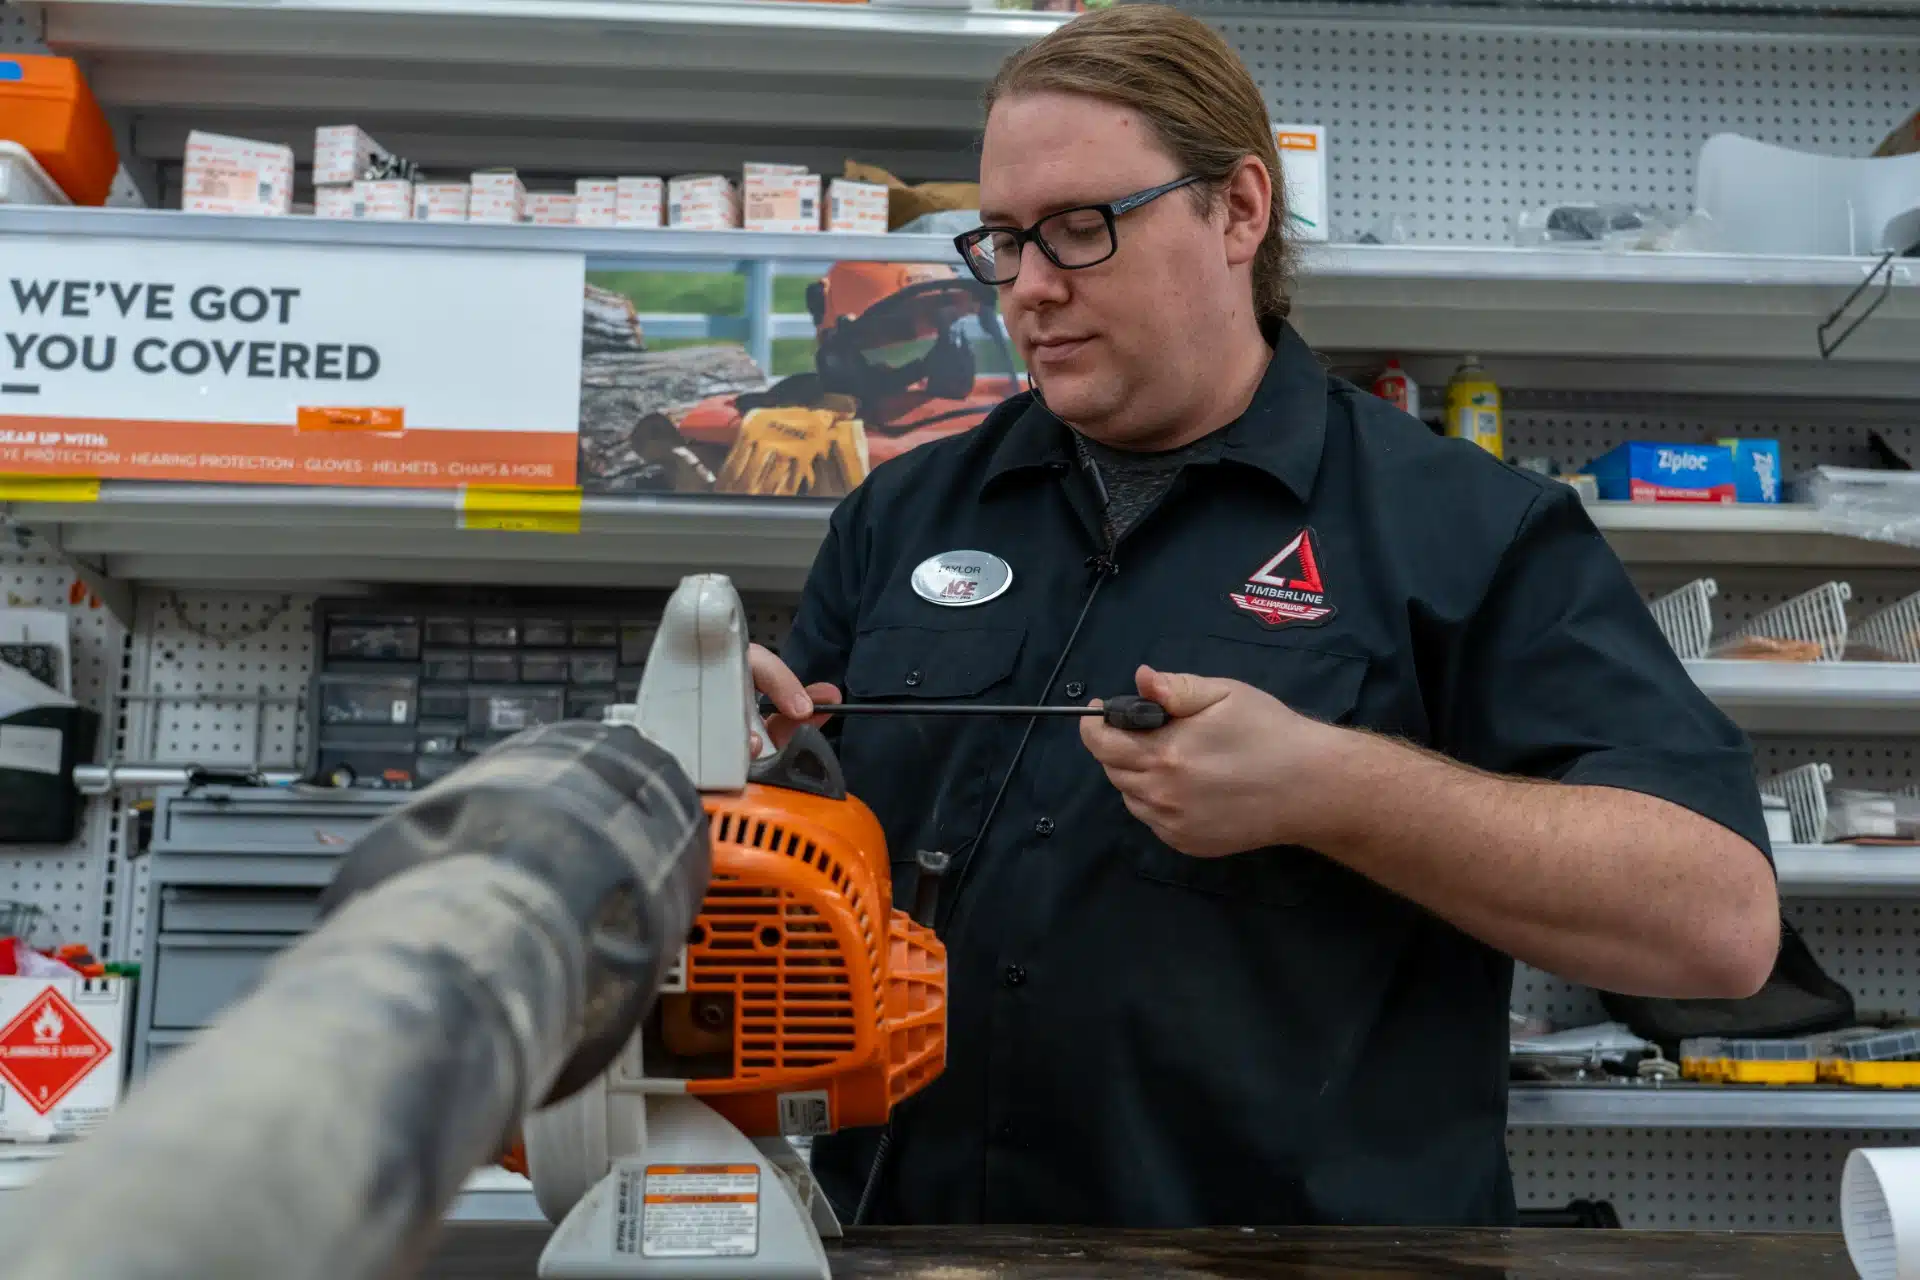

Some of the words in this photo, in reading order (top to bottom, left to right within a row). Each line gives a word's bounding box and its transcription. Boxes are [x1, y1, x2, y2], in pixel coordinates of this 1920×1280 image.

[190, 285, 301, 325] GOT
[5, 333, 117, 372] YOU
[133, 337, 381, 381] COVERED
[39, 432, 61, 445] UP
[24, 449, 120, 465] PROTECTION
[131, 454, 197, 468] HEARING
[199, 456, 294, 470] PROTECTION
[304, 458, 362, 474] GLOVES
[372, 461, 438, 476] HELMETS
[448, 462, 497, 476] CHAPS
[499, 465, 509, 476] &
[512, 463, 553, 478] MORE
[1657, 450, 1708, 474] Ziploc
[941, 579, 978, 597] ACE
[1244, 583, 1324, 605] TIMBERLINE
[1251, 598, 1266, 608] ACE
[1266, 599, 1305, 613] HARDWARE
